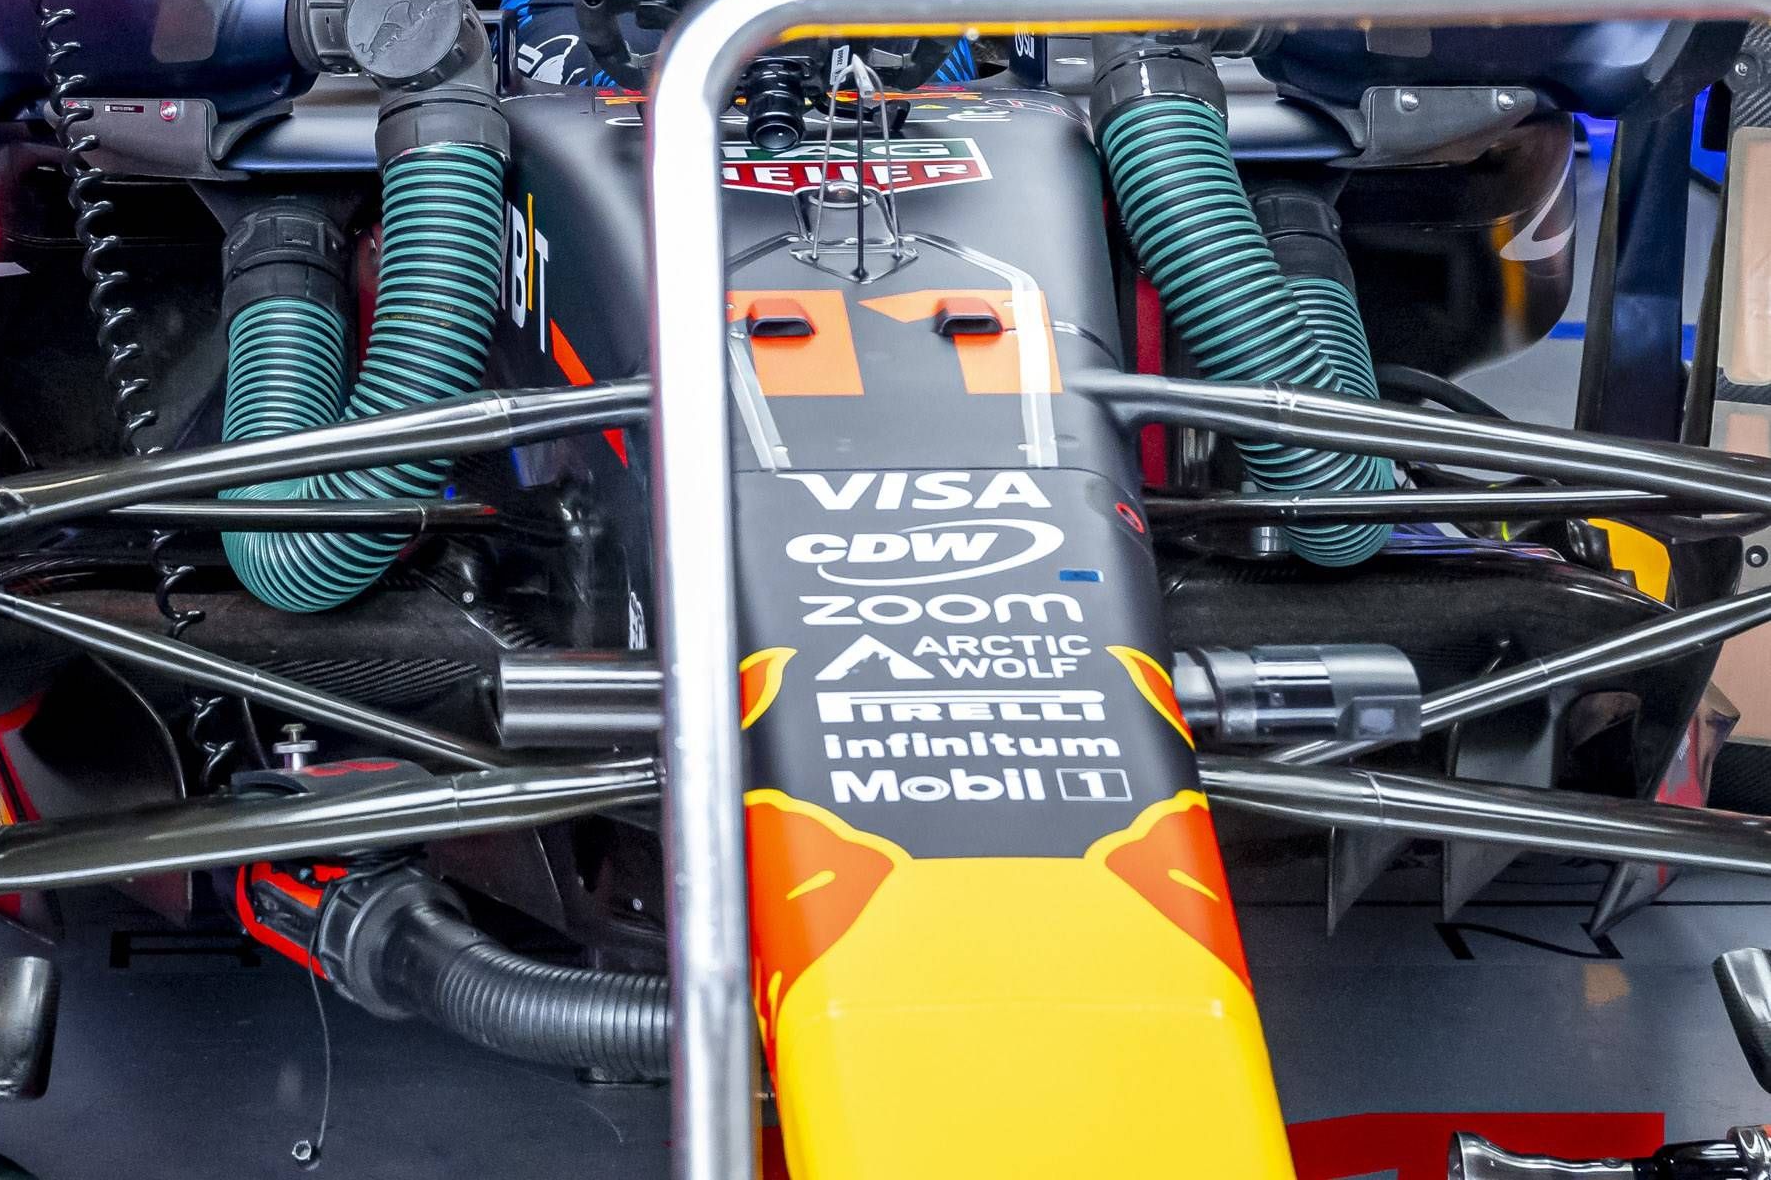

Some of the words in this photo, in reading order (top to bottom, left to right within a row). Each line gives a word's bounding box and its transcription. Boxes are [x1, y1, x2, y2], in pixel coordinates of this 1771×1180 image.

[726, 289, 1064, 396] 11
[776, 471, 1053, 510] VISA
[785, 531, 1000, 564] CDW
[798, 592, 1085, 626] zoom
[912, 635, 1092, 657] ARCTIC
[938, 657, 1079, 679] WOLF
[816, 689, 1106, 723] PIRELLI
[824, 731, 1121, 760] infinitum
[830, 767, 1046, 804] Mobil
